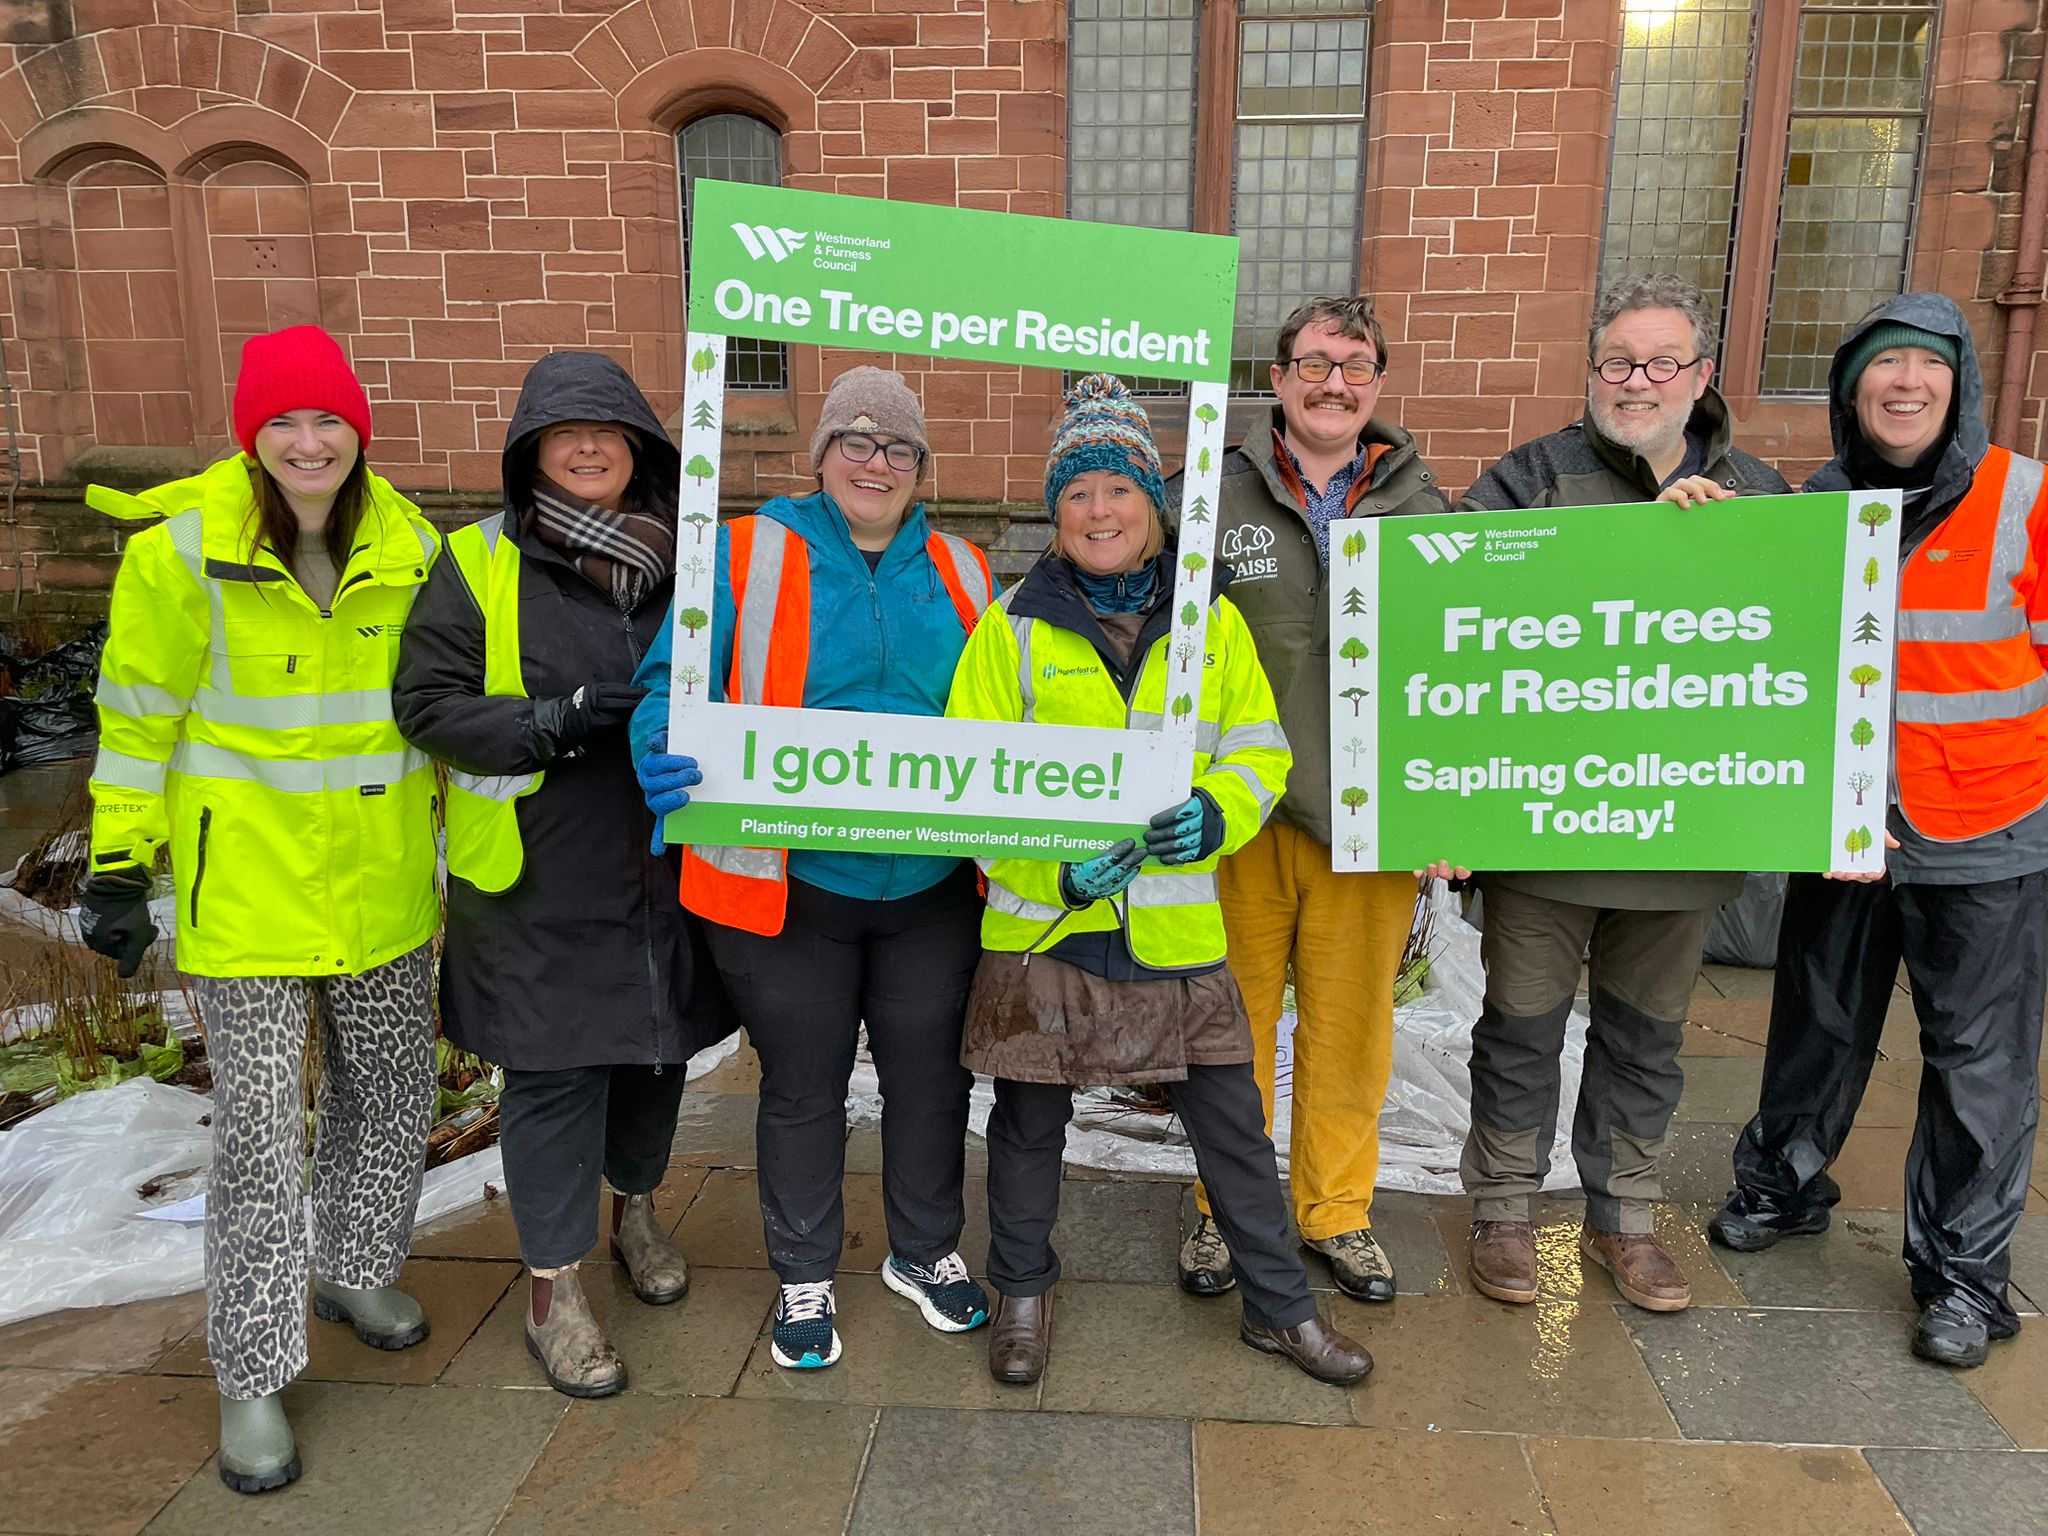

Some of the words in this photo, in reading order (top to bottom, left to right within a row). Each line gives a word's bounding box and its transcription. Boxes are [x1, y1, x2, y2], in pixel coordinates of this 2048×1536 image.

[813, 230, 891, 250] Westmorland
[813, 243, 823, 255] &
[824, 244, 872, 261] Furness
[812, 257, 857, 273] Council
[713, 278, 812, 327] One
[819, 288, 924, 339] Tree
[930, 311, 1009, 350] per
[1014, 308, 1212, 367] Resident
[1484, 526, 1557, 539] Westmorland
[1484, 540, 1493, 551] &
[1495, 540, 1539, 550] Furness
[1484, 550, 1525, 563] Council
[1443, 606, 1582, 653] Free
[1592, 599, 1772, 646] Trees
[1404, 672, 1491, 717] for
[1501, 662, 1809, 714] Residents
[743, 729, 758, 781] I
[772, 739, 875, 795] got
[888, 751, 977, 803] my
[991, 747, 1124, 801] tree!
[1403, 757, 1567, 797] Sapling
[1573, 751, 1805, 788] Collection
[741, 818, 808, 840] Planting
[811, 822, 835, 837] for
[836, 826, 847, 838] a
[848, 826, 913, 844] greener
[915, 827, 1019, 846] Westmorland
[1021, 833, 1051, 848] and
[1053, 833, 1115, 851] Furness
[1522, 799, 1675, 841] Today!
